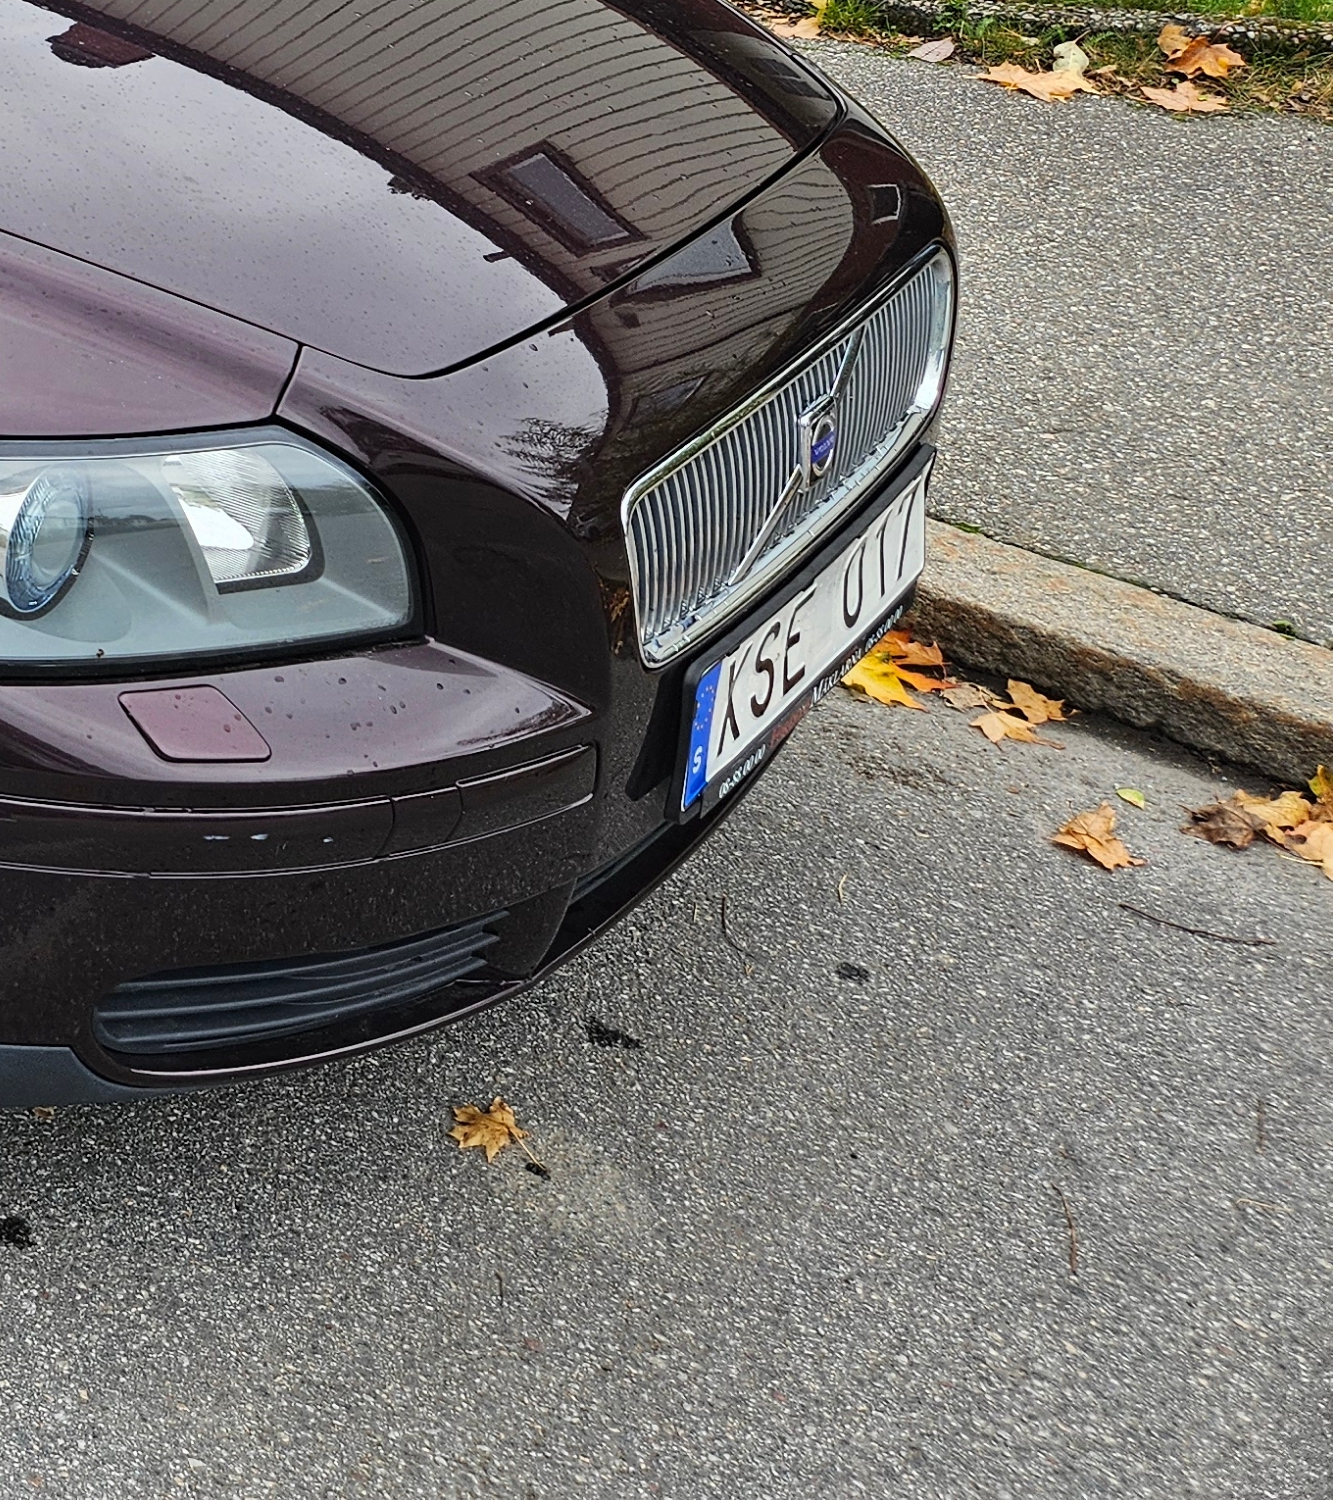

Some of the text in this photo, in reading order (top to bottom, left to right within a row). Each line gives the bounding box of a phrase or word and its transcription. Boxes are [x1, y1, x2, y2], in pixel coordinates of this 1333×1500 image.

[716, 584, 818, 759] KSE
[843, 475, 922, 629] 017
[692, 745, 703, 775] S
